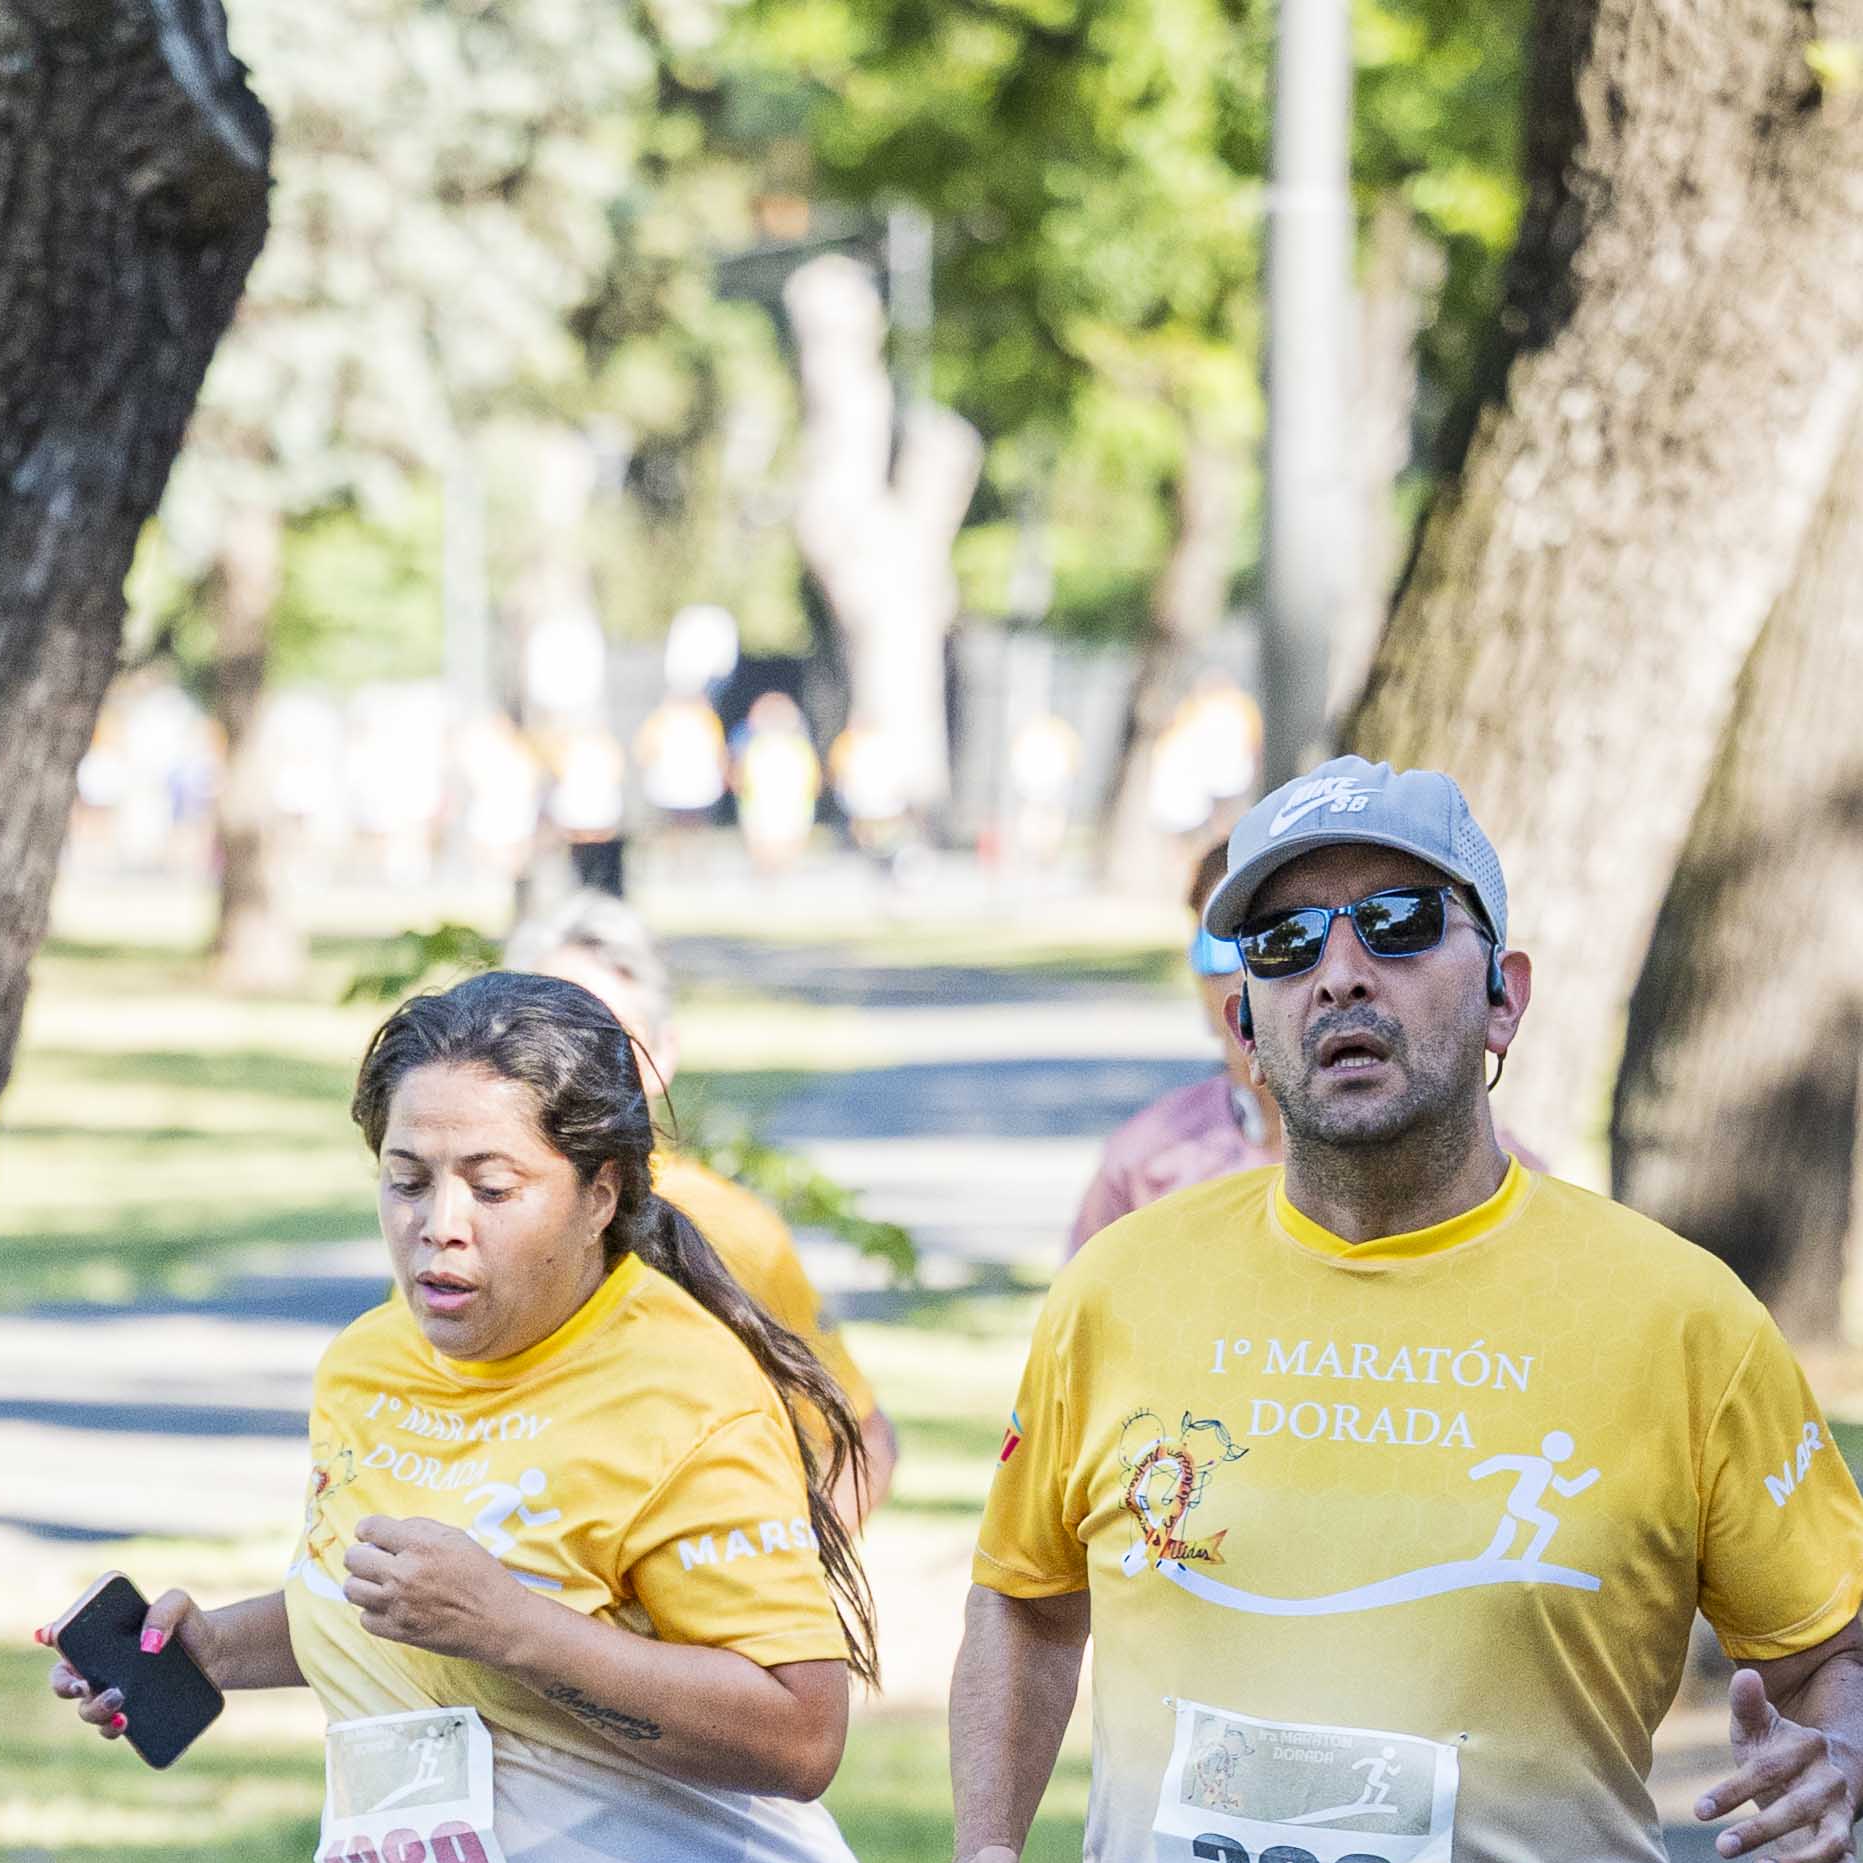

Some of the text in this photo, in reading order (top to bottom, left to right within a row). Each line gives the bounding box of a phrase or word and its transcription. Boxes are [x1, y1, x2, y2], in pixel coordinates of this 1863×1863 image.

[1329, 796, 1369, 814] SB
[1262, 1338, 1536, 1393] MARATÓN
[1247, 1399, 1477, 1449] DORADA
